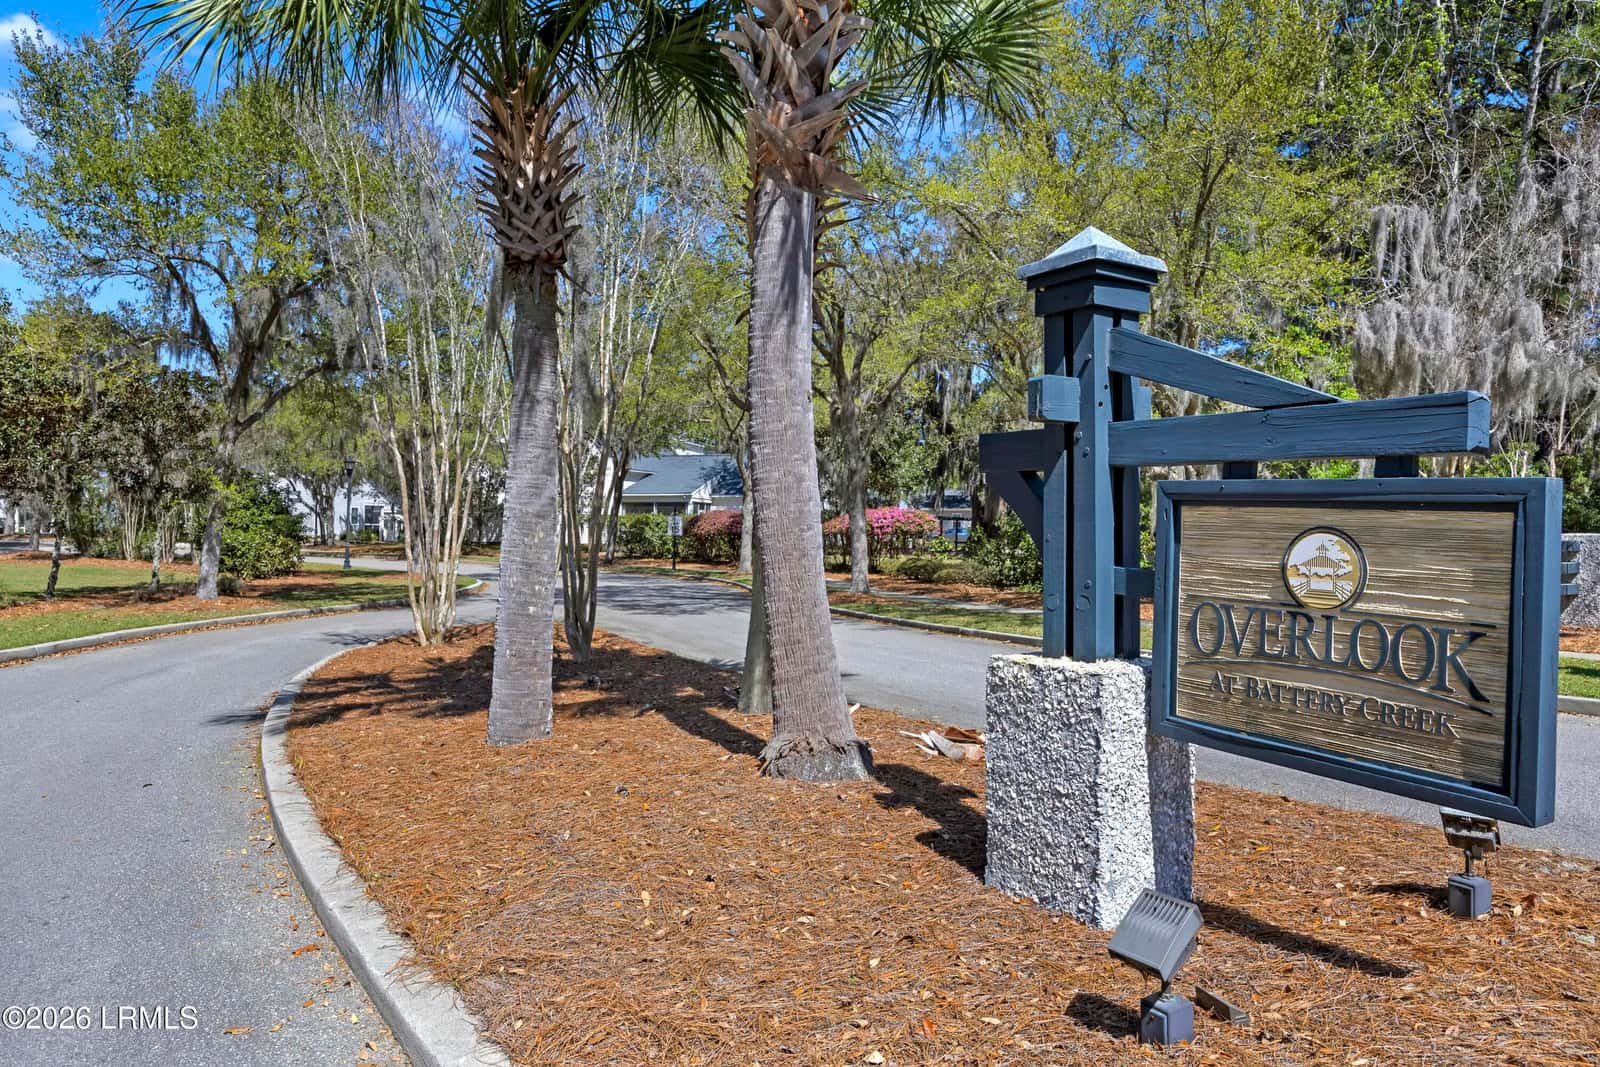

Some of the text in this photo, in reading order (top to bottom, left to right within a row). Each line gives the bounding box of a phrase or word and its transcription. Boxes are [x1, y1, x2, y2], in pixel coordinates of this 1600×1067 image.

[1189, 601, 1490, 703] OVERLOOK
[1209, 670, 1461, 739] AT BATTERY CREEK
